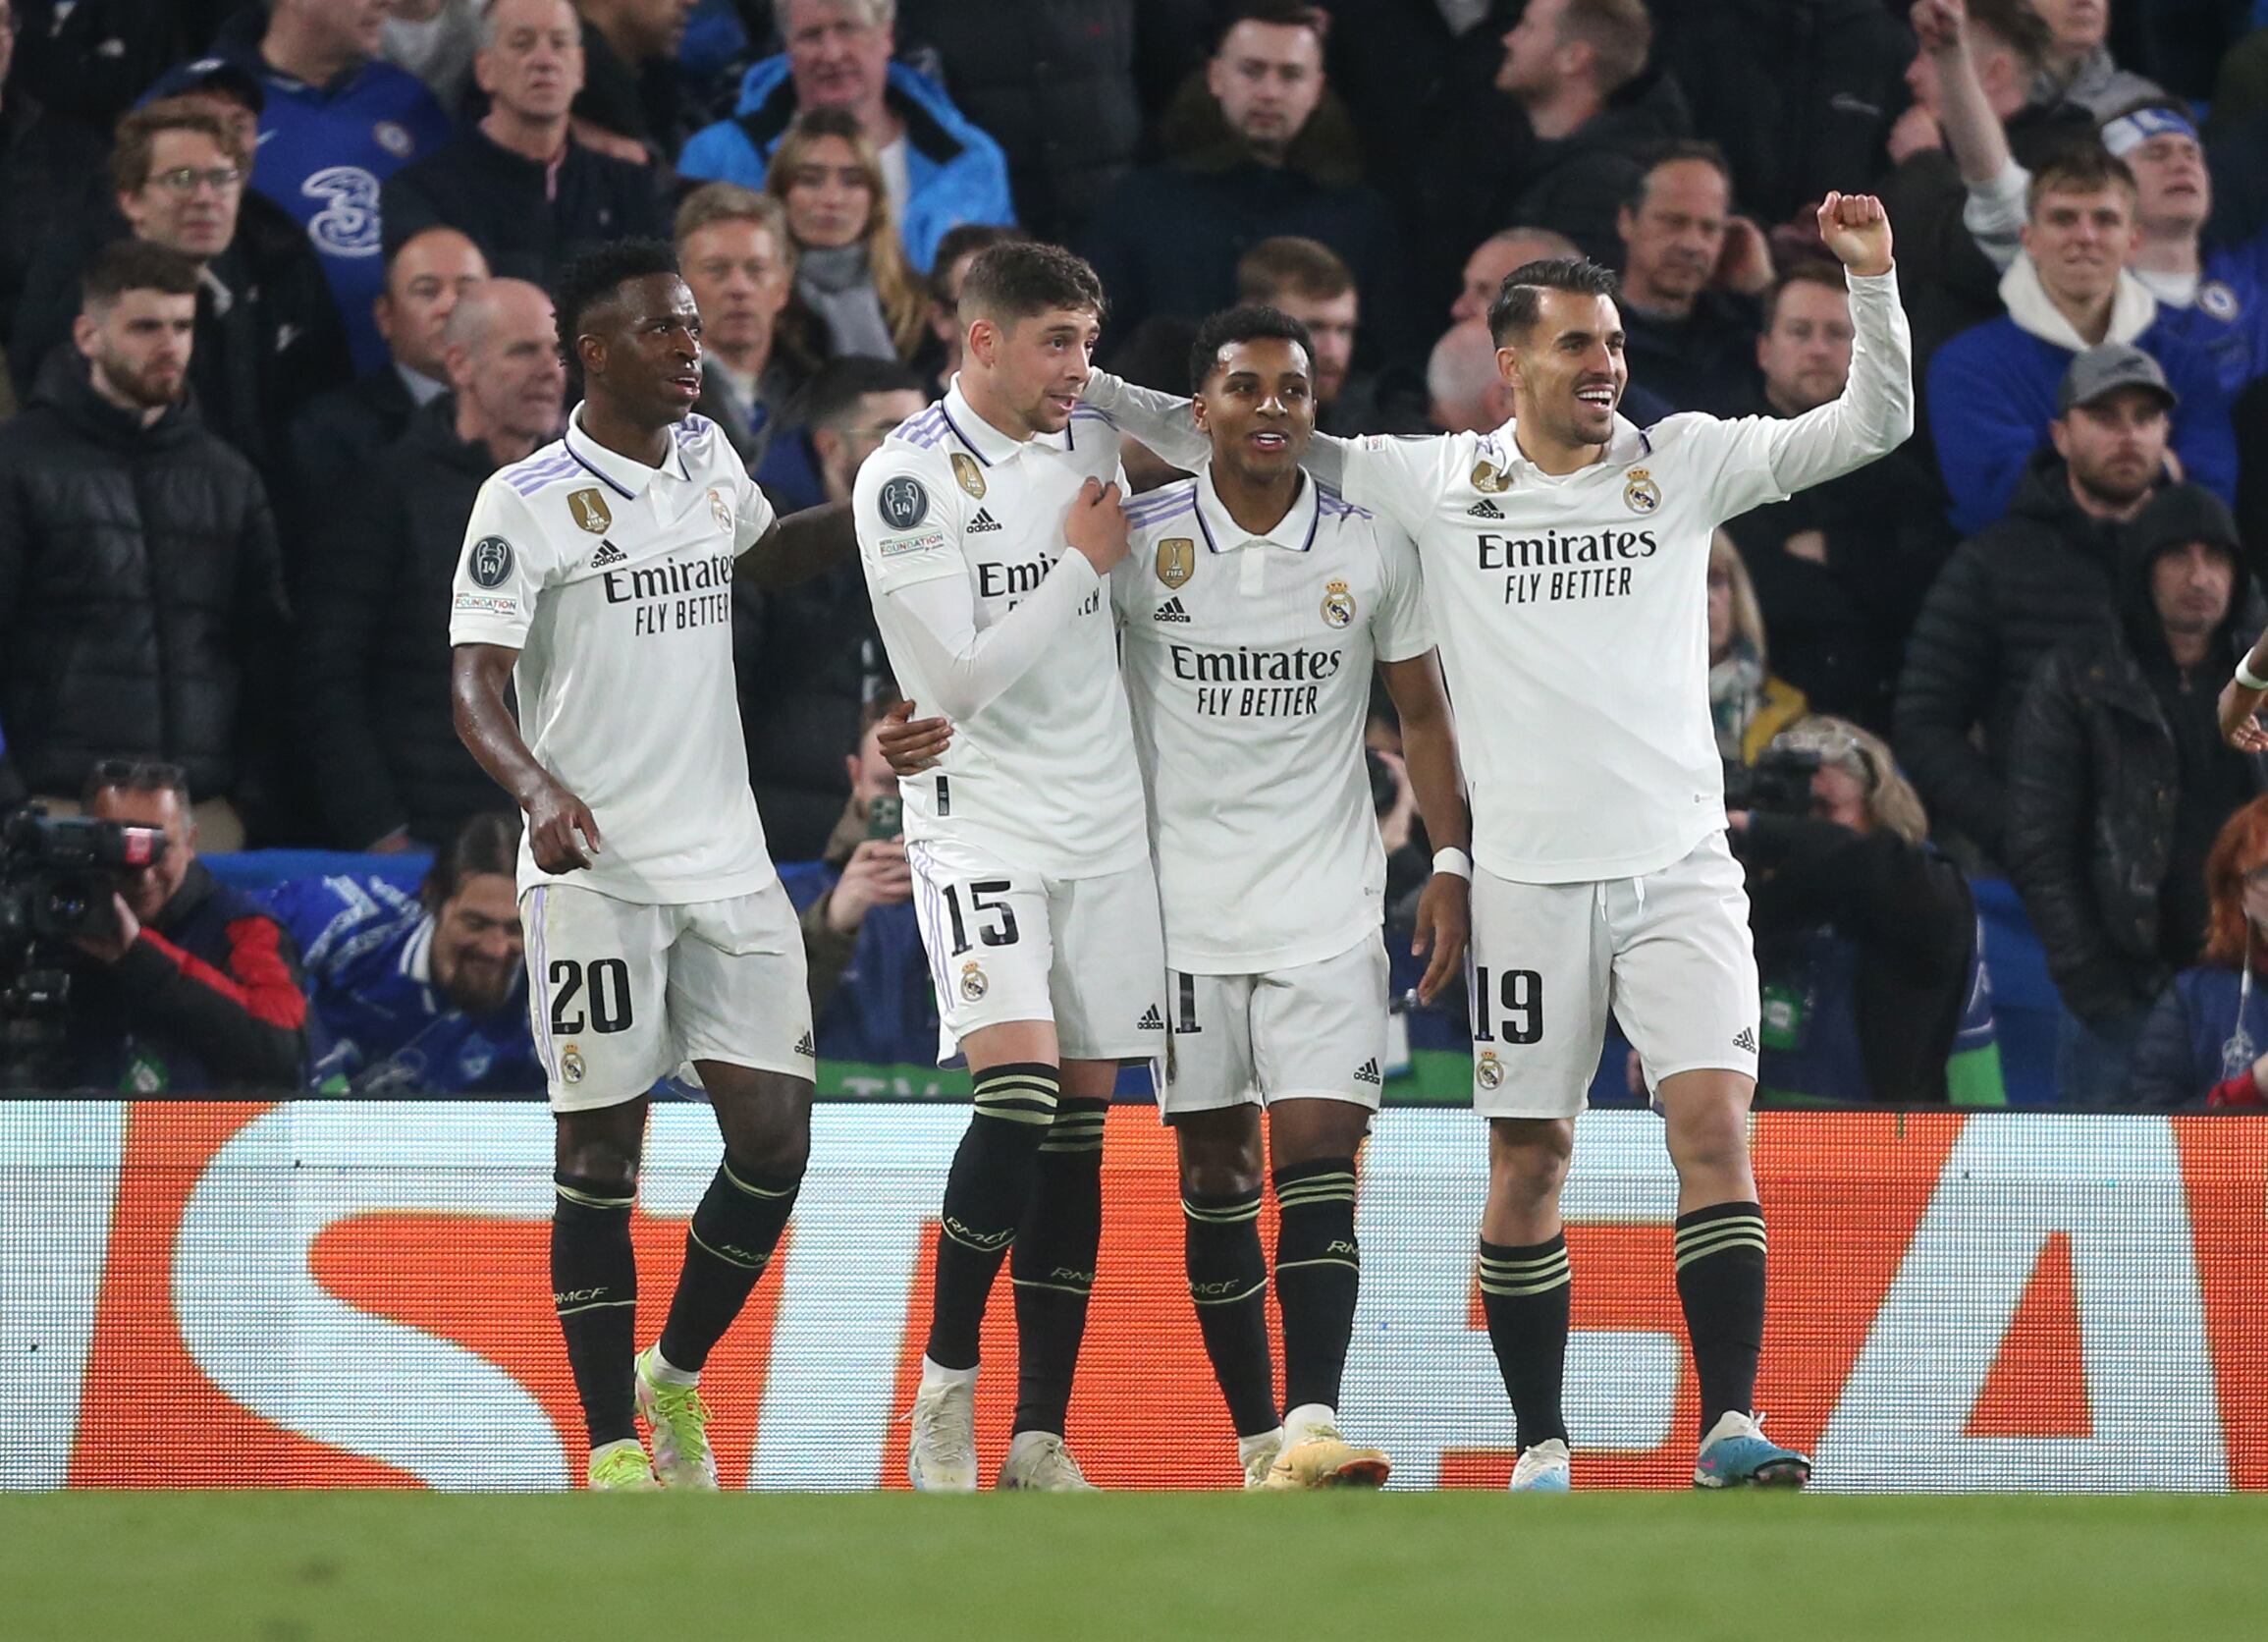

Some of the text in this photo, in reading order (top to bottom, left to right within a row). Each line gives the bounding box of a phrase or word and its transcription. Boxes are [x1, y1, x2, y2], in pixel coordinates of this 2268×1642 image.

[896, 501, 911, 516] 14
[1467, 509, 1505, 520] adidas
[966, 520, 1002, 534] adidas
[880, 532, 944, 556] FOUNDATION
[1477, 528, 1657, 570] Emirates
[482, 561, 497, 575] 14
[591, 552, 628, 569] adidas
[603, 555, 735, 604] Emirates
[1505, 567, 1632, 604] FLY BETTER
[455, 596, 517, 610] FOUNDATION
[1154, 613, 1191, 623] adidas
[635, 603, 668, 636] FLY
[1170, 645, 1342, 682] Emirates
[1197, 685, 1318, 717] FLY BETTER
[942, 880, 1019, 958] 15
[549, 958, 633, 1034] 20
[1167, 971, 1202, 1034] 1
[1474, 966, 1543, 1045] 19
[1137, 1018, 1164, 1030] adidas
[0, 1101, 974, 1491] ST
[1189, 1279, 1239, 1295] MCF
